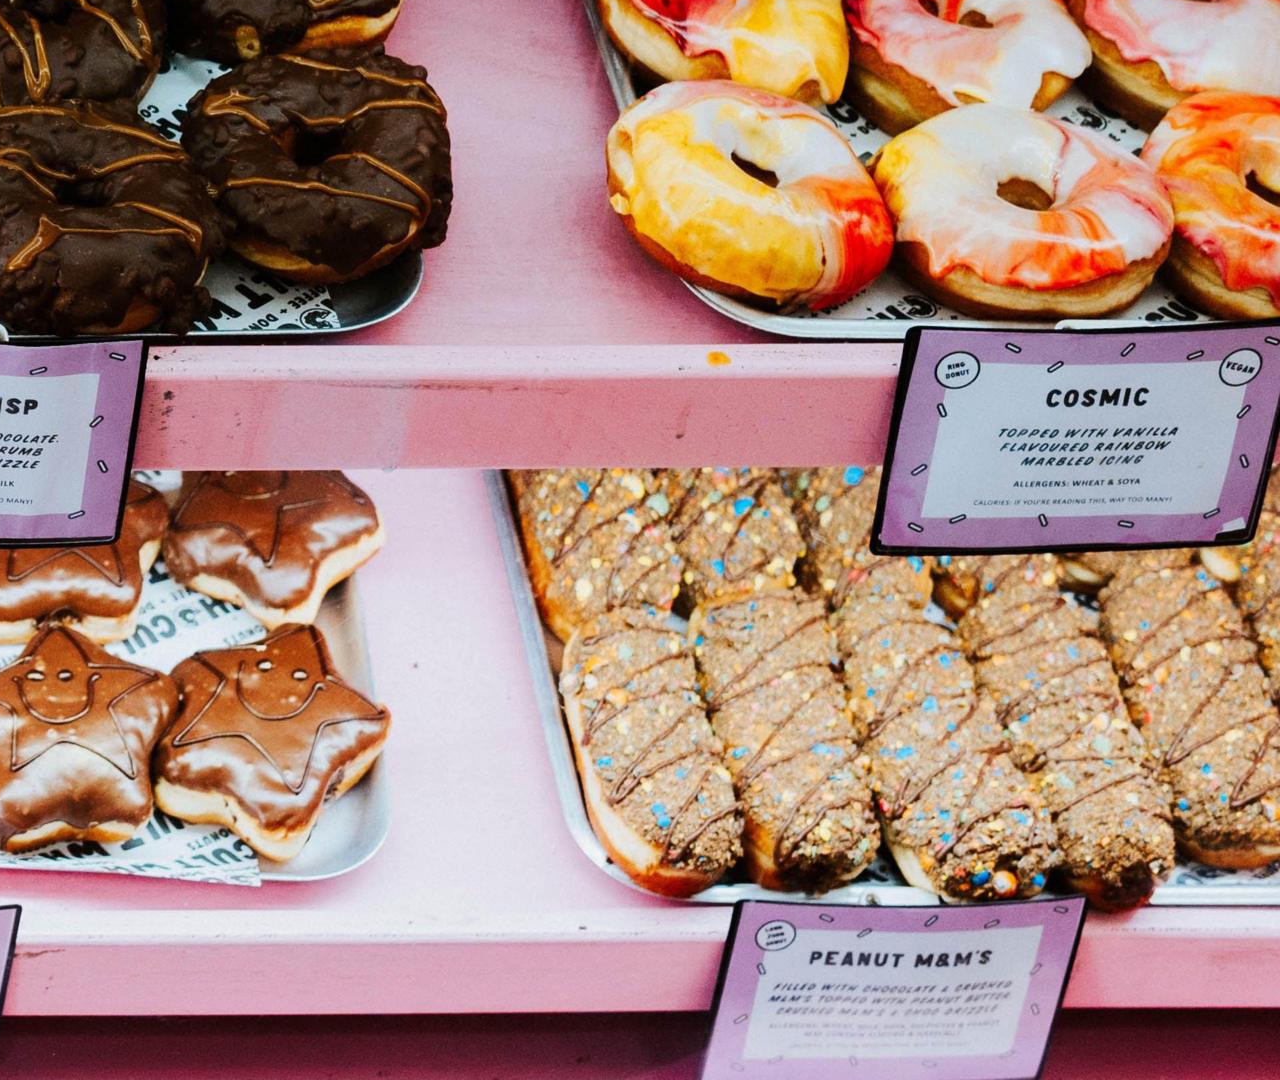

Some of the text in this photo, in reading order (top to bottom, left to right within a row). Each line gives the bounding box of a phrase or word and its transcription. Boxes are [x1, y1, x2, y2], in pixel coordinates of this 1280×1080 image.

[946, 361, 966, 371] RING
[1225, 360, 1255, 374] VEGAN
[945, 368, 970, 380] DONUT
[1046, 387, 1149, 408] COSMIC
[998, 426, 1179, 439] TOPPED WITH VANILLA
[1000, 440, 1171, 453] FLAVOURED RAINBOW
[1020, 454, 1144, 467] MARBLED ICING
[809, 950, 993, 968] PEANUT M&M'S
